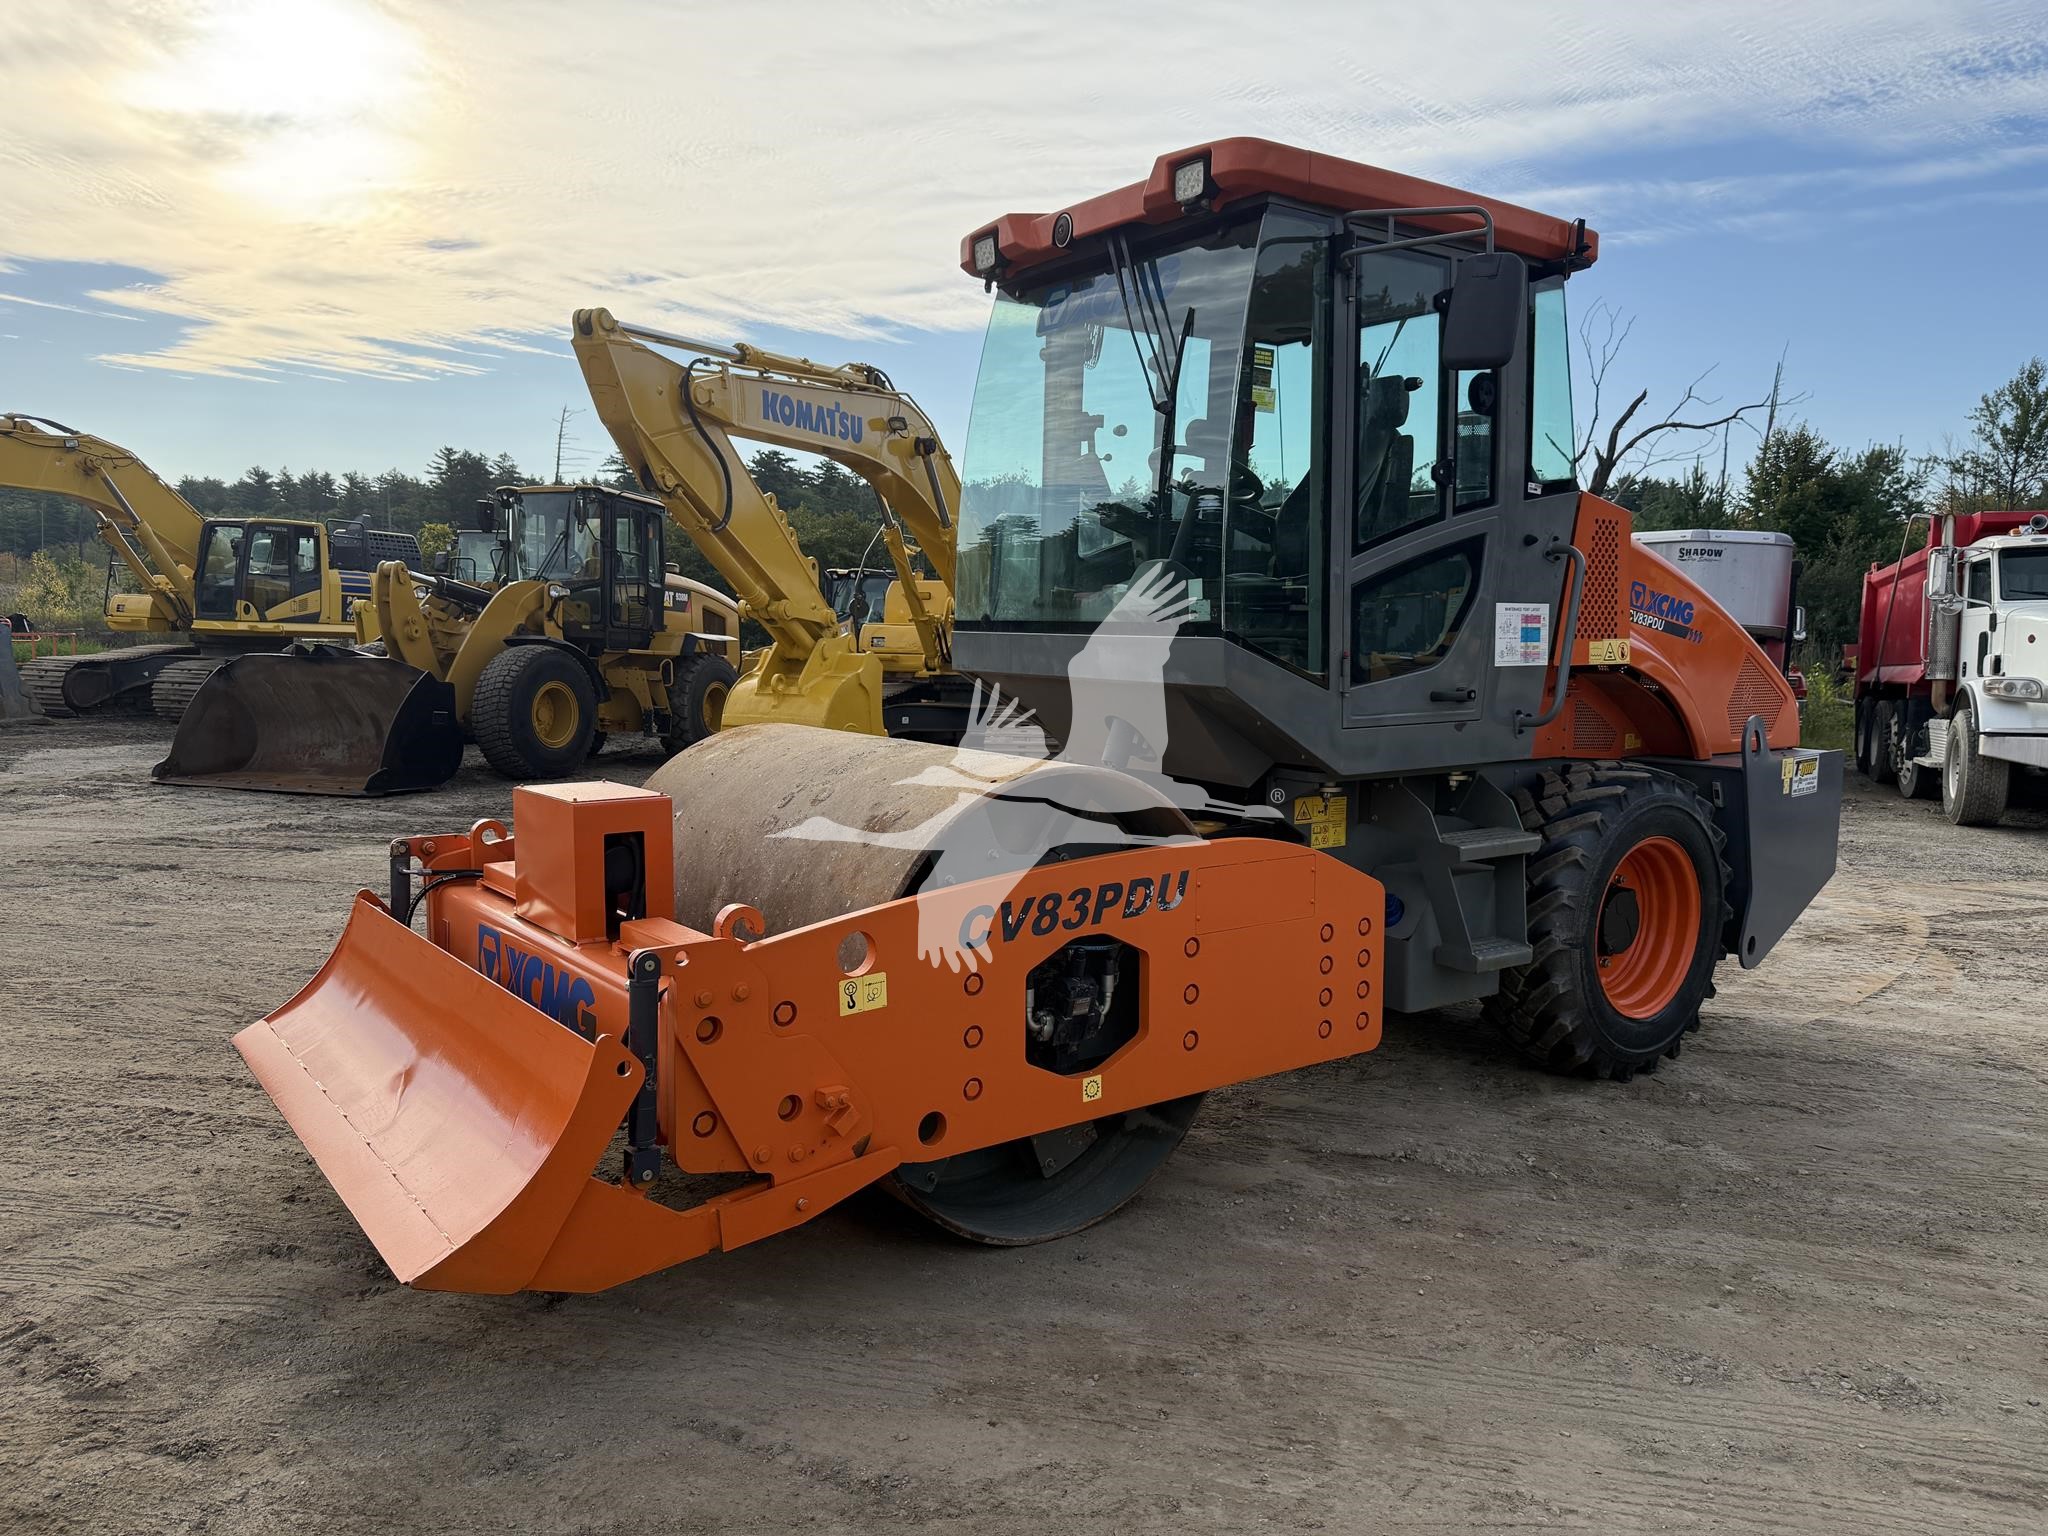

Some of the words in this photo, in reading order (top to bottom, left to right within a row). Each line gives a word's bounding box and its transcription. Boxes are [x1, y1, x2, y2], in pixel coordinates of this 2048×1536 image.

[762, 389, 863, 443] KOMATSU
[1678, 547, 1723, 558] SHADOW
[664, 590, 674, 608] AT
[1644, 589, 1695, 625] XCMG
[958, 870, 1190, 950] CV83PDU
[505, 944, 597, 1044] XCMG
